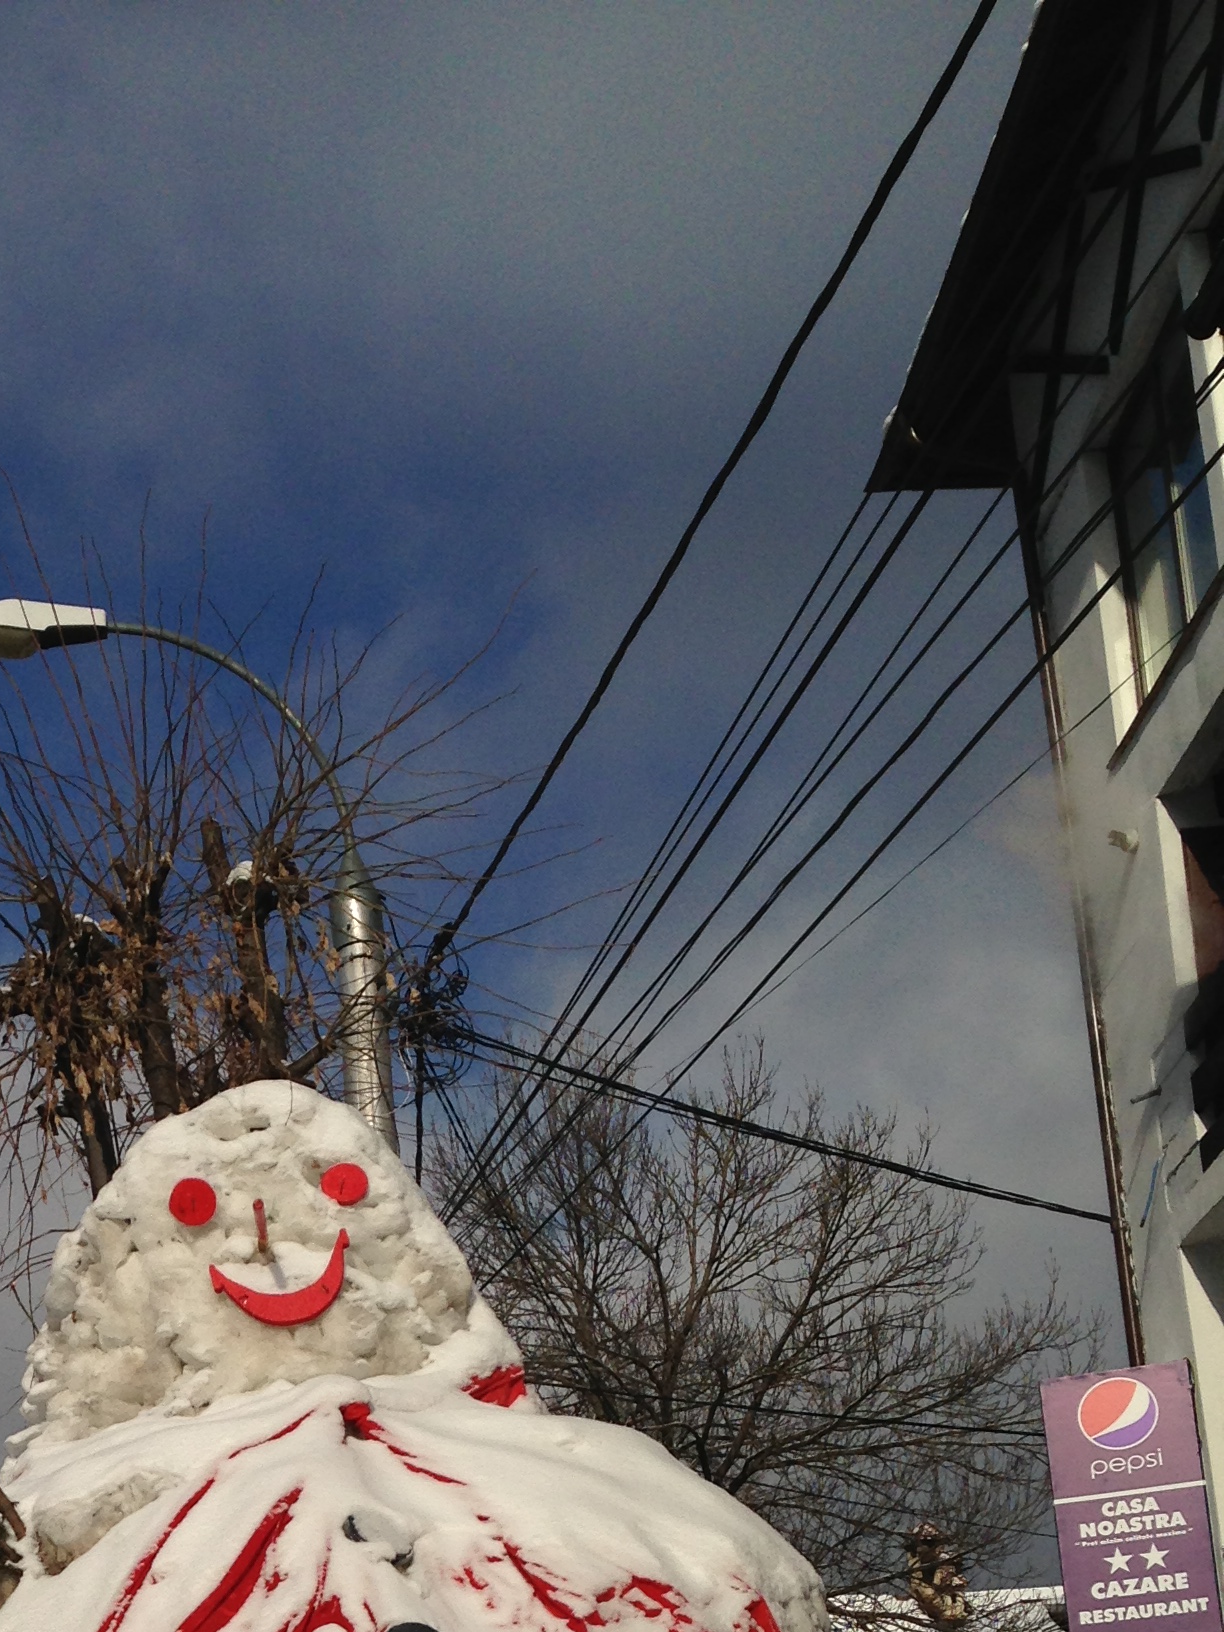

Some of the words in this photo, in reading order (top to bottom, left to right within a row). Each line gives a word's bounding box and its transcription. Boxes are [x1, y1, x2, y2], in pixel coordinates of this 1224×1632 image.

[1090, 1447, 1164, 1480] pepsi
[1101, 1496, 1160, 1517] CASA
[1079, 1511, 1187, 1539] NOASTRA
[1091, 1572, 1189, 1600] CAZARE
[1079, 1597, 1209, 1625] RESTAURANT
